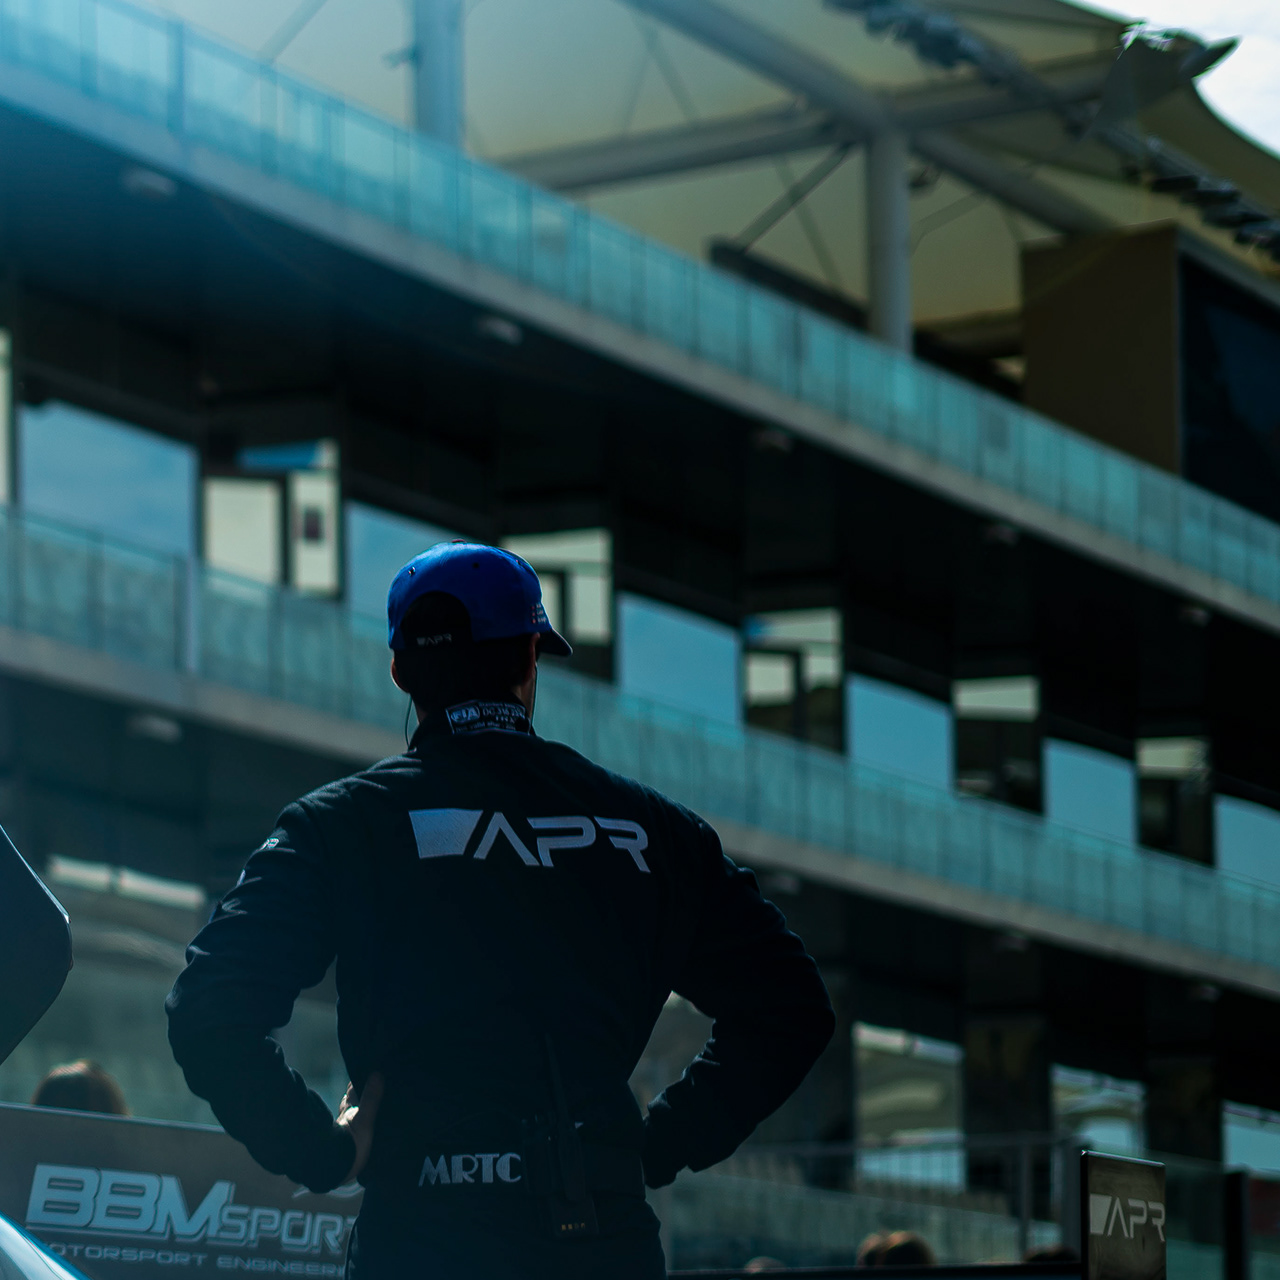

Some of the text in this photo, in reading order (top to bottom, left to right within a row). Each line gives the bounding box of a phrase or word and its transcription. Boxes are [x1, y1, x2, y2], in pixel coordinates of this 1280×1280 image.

[473, 810, 651, 875] APR
[418, 1152, 522, 1187] MRTC
[1107, 1196, 1166, 1243] APR
[48, 1242, 209, 1267] OTORSPORT
